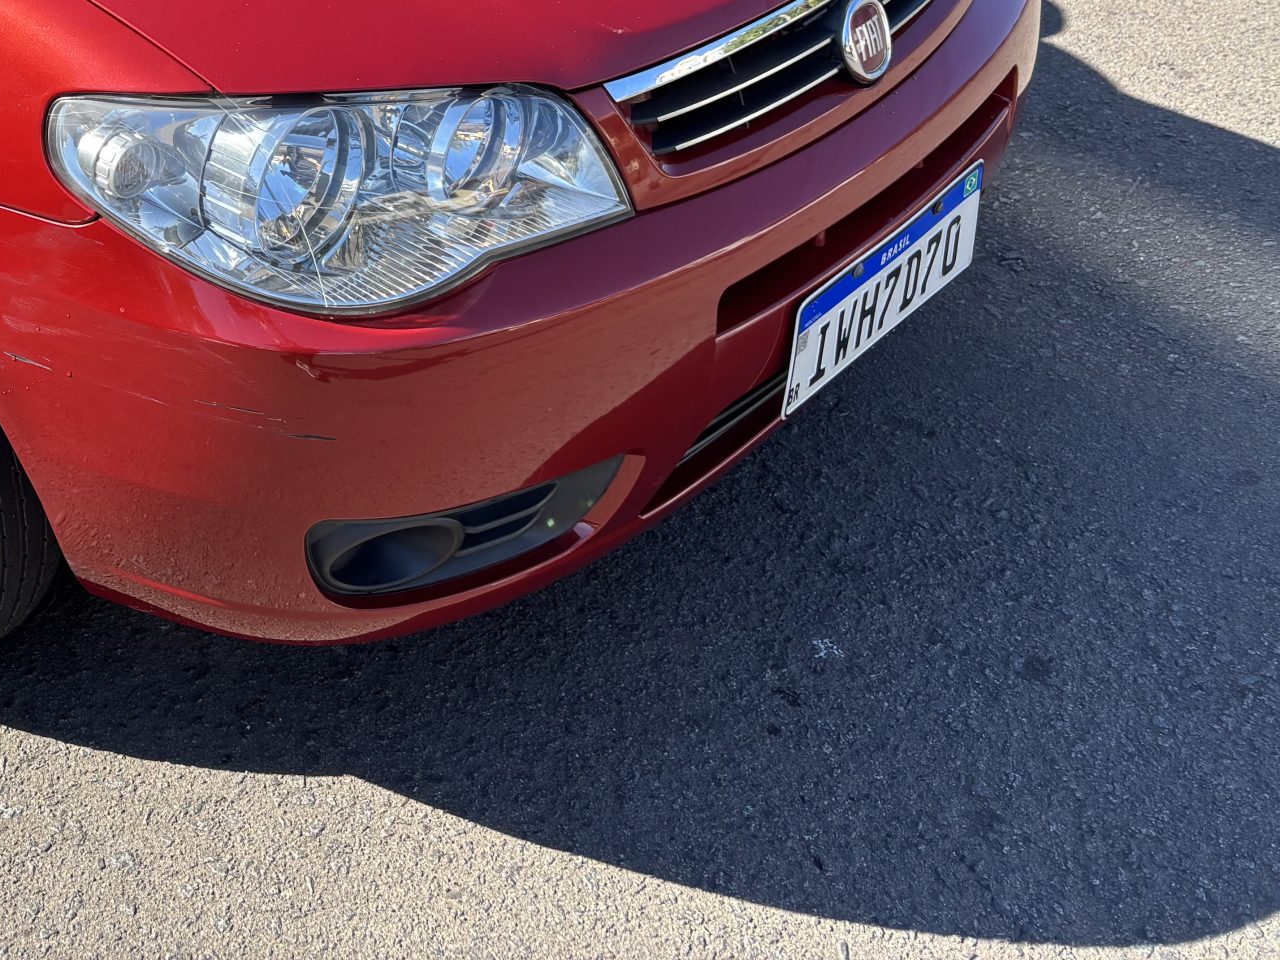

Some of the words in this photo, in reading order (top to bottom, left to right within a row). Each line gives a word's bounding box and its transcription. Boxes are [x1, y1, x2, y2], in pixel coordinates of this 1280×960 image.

[855, 14, 884, 62] FIAT
[880, 234, 910, 266] BRASIL
[808, 214, 962, 388] IWH7D70
[786, 383, 801, 407] BR
